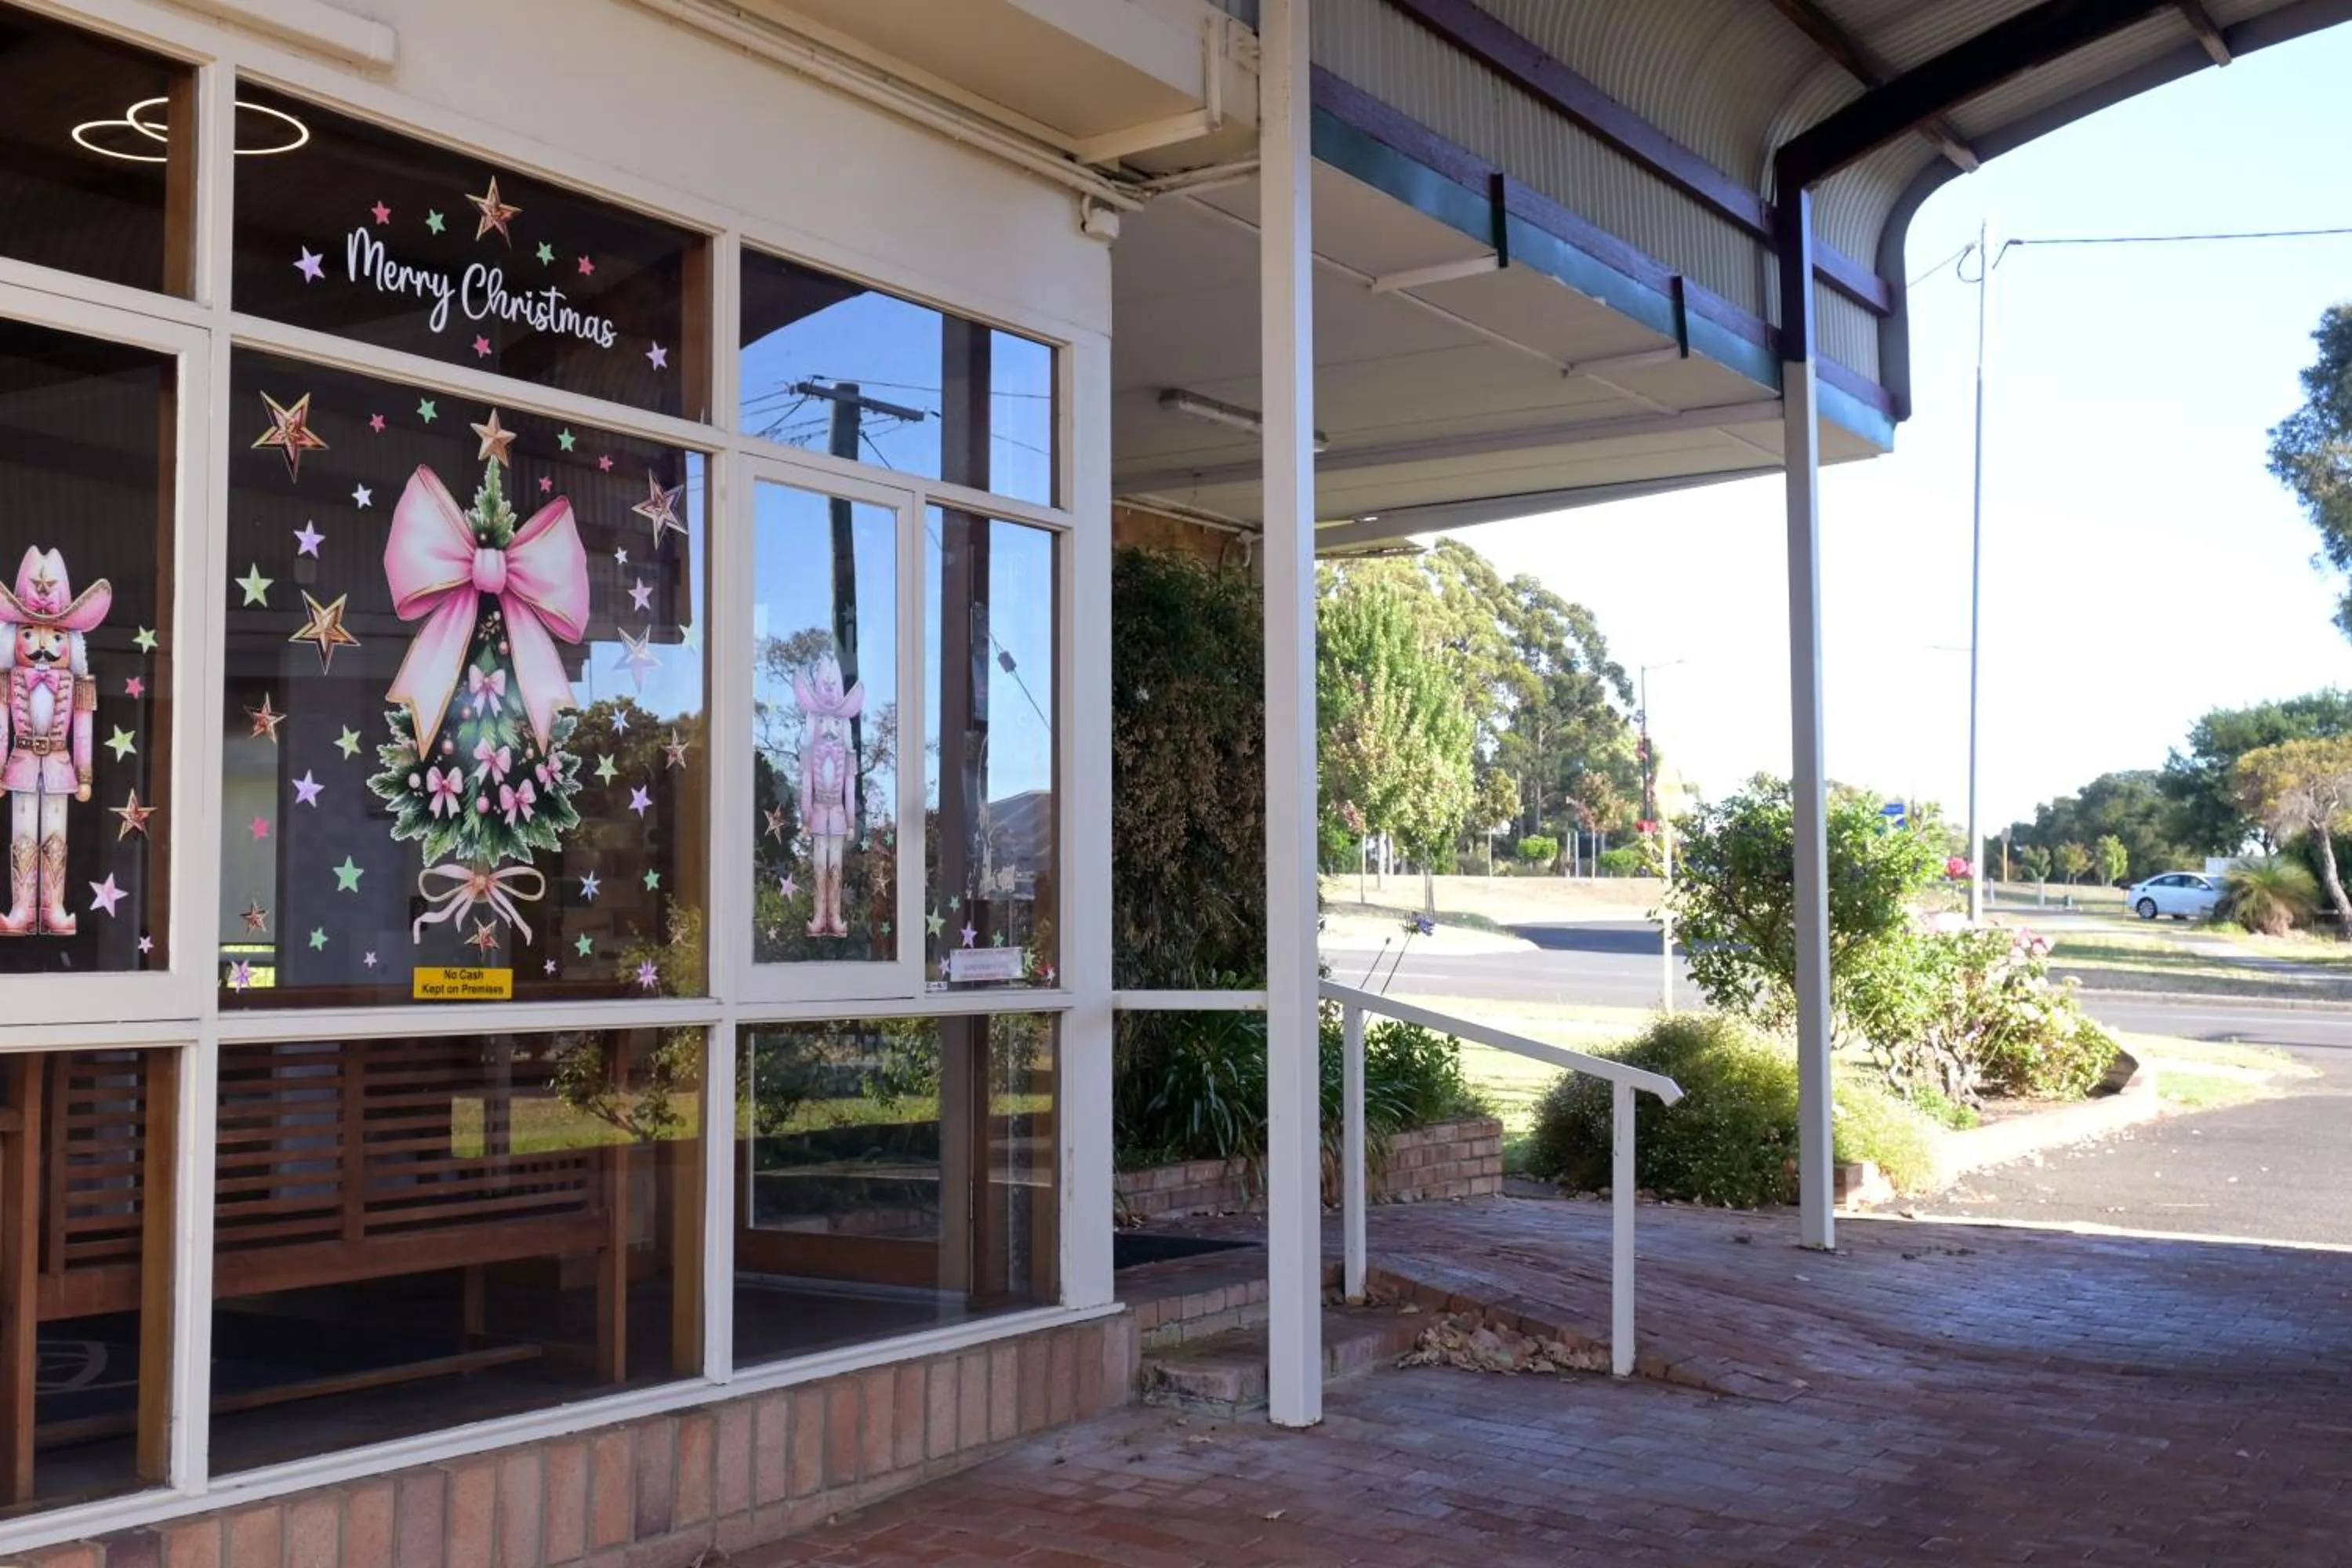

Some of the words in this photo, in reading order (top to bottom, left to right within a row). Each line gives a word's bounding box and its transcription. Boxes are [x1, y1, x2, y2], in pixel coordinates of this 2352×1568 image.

[347, 227, 456, 333] Merry
[461, 263, 618, 350] Christmas
[444, 969, 457, 979] No
[459, 969, 484, 980] Cash
[422, 984, 445, 995] Kept
[447, 985, 459, 994] on
[461, 984, 504, 995] Premises
